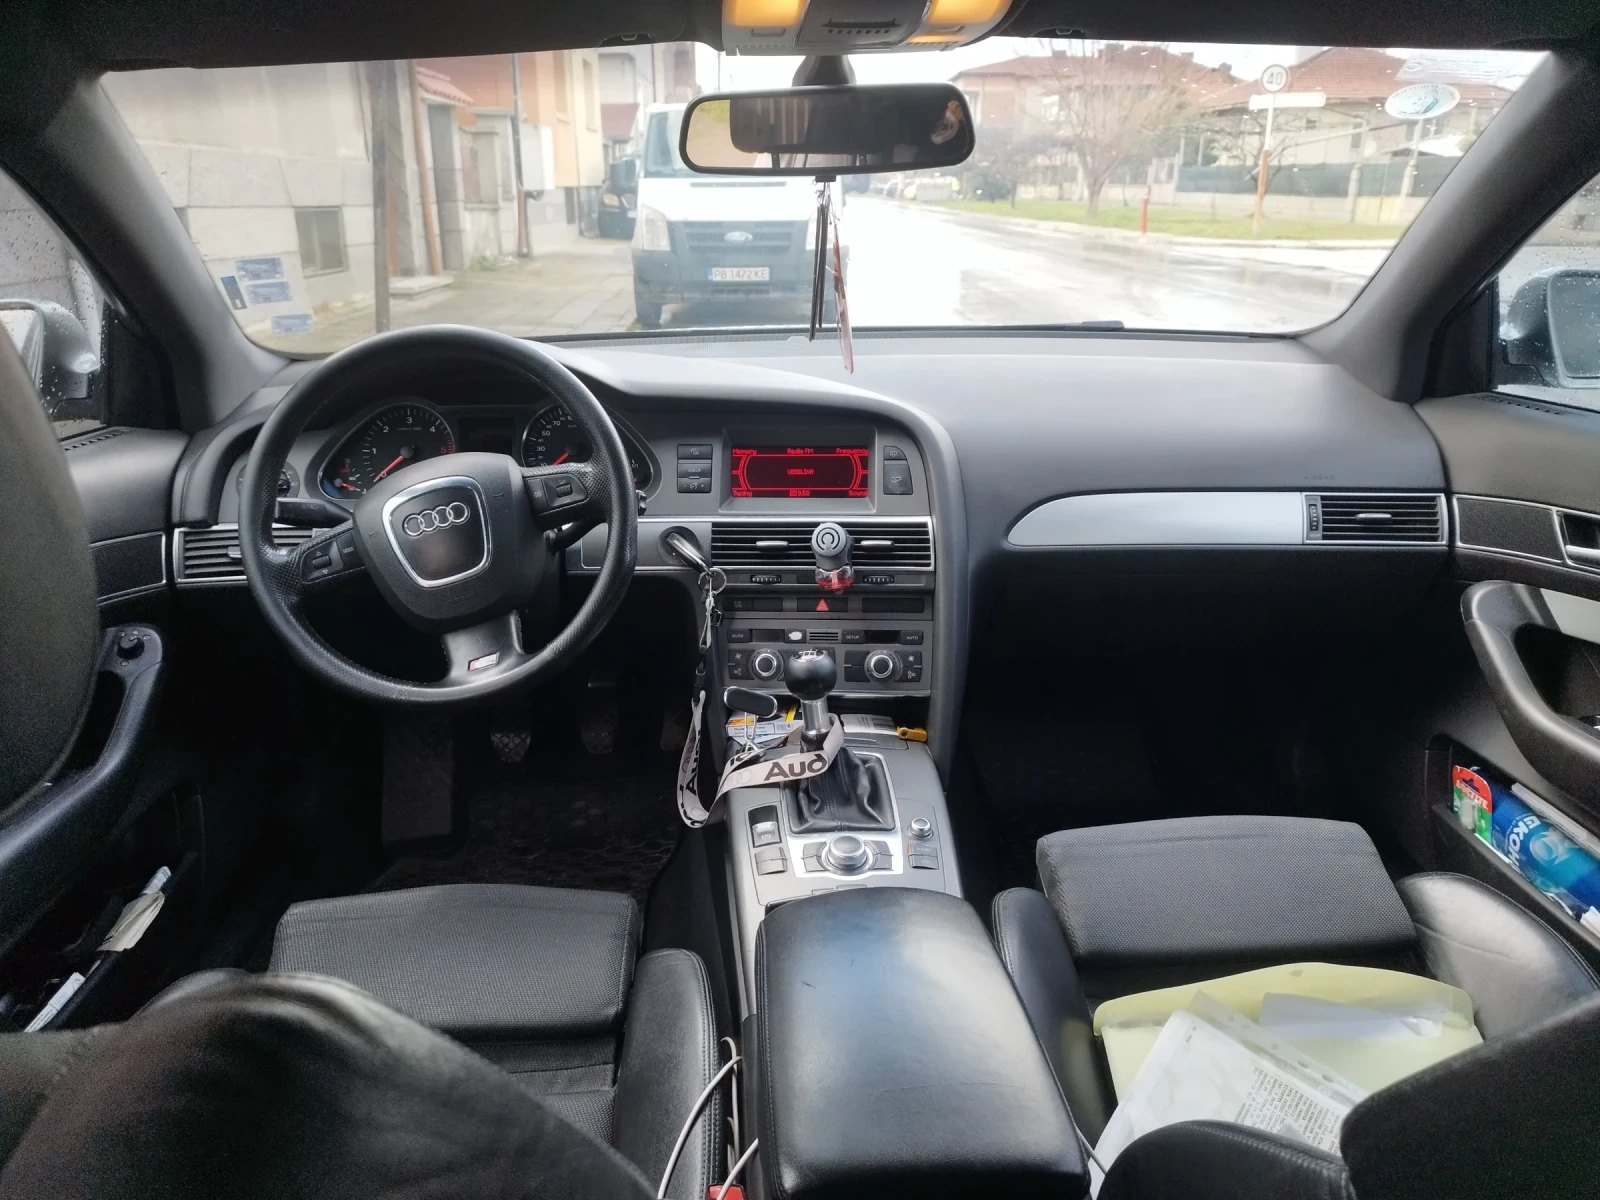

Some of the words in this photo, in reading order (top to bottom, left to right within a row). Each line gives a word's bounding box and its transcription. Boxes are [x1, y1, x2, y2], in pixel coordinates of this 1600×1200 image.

[1266, 72, 1284, 86] 40
[730, 269, 753, 280] 1472
[406, 416, 413, 424] 3
[371, 447, 377, 455] 1
[732, 448, 758, 456] Memory
[786, 447, 804, 455] Radio
[835, 447, 869, 455] Frequency
[786, 468, 815, 476] VESELINA
[732, 489, 753, 498] Tuning
[848, 489, 869, 497] Sound
